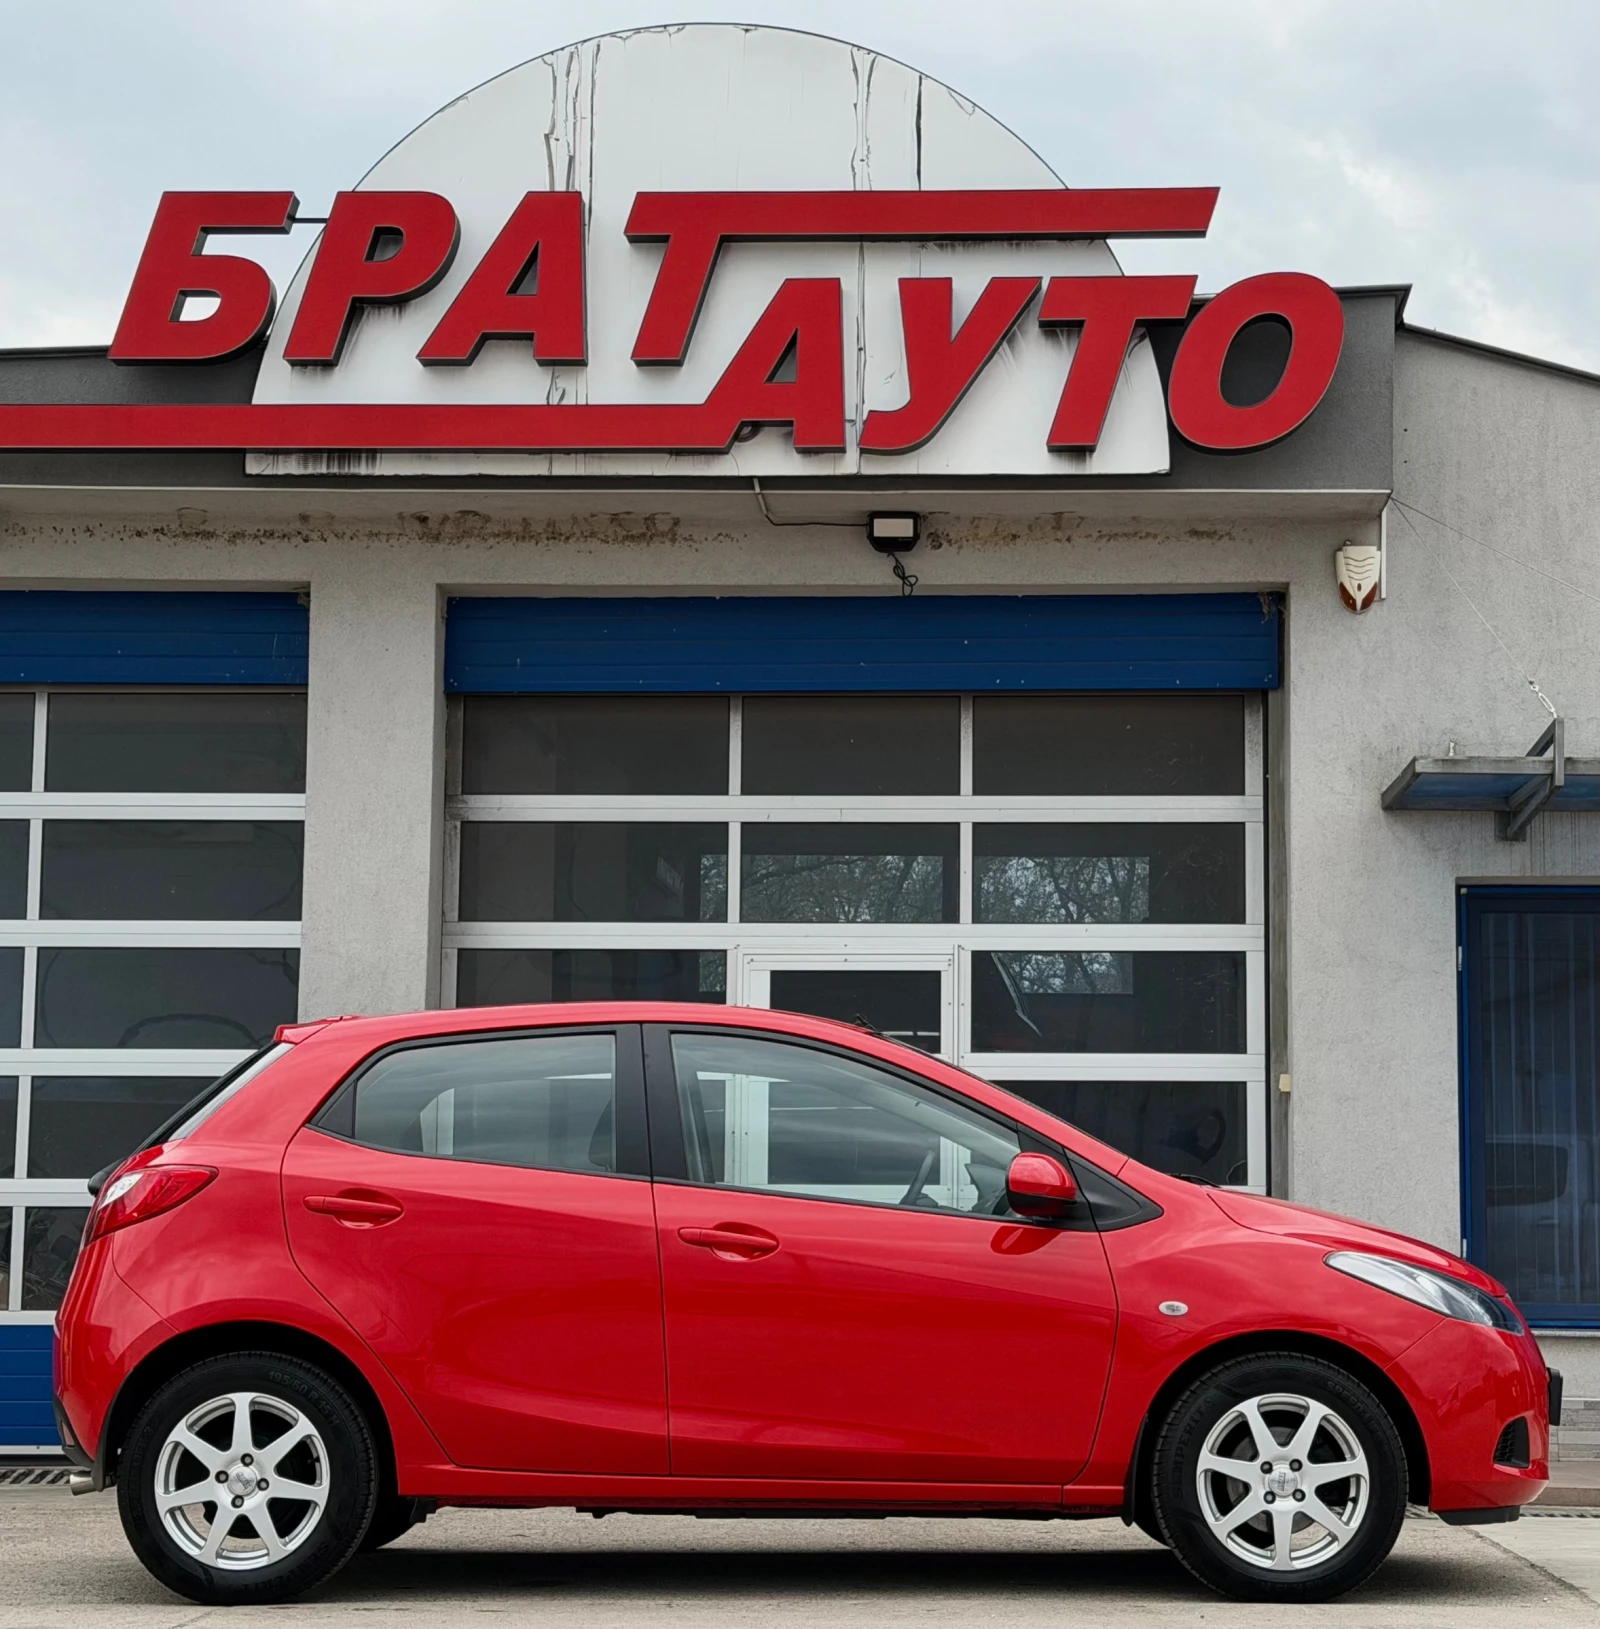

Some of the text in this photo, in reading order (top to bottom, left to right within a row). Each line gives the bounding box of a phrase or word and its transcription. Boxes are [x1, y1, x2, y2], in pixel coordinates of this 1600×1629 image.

[108, 187, 1220, 366] БРАТ
[665, 272, 1345, 455] АУТО
[268, 1370, 308, 1394] 195/60
